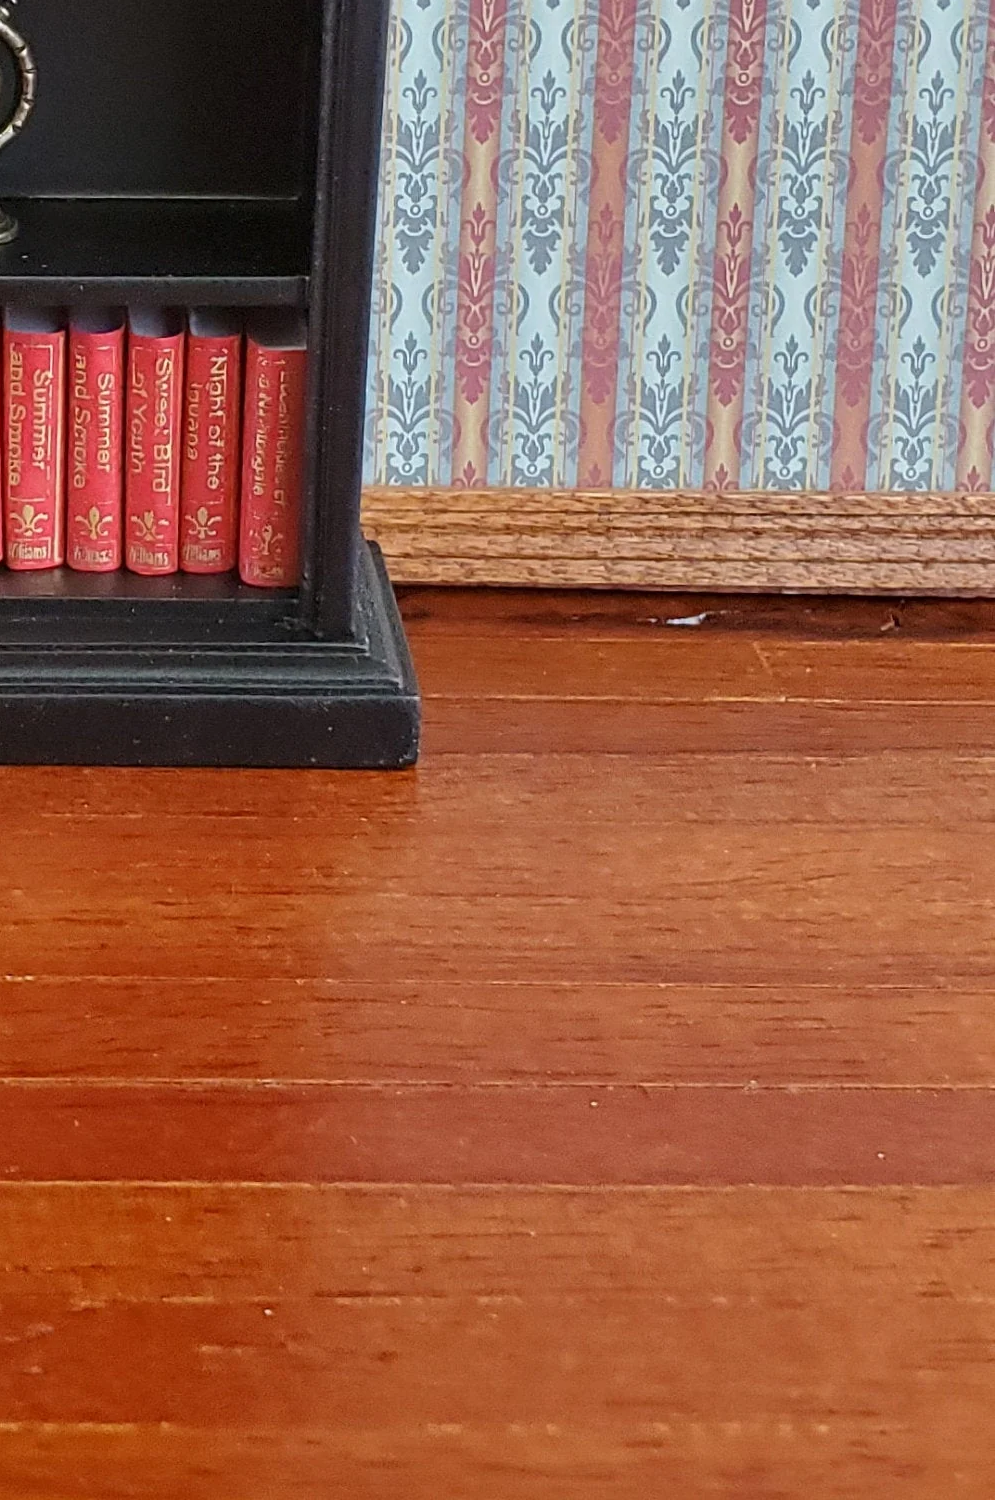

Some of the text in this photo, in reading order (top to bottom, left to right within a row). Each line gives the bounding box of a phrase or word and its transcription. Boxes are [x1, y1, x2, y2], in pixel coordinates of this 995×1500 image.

[9, 352, 27, 487] and Smoke
[32, 369, 53, 470] Summer
[73, 354, 94, 488] and Smoke
[96, 373, 115, 473] Summer
[131, 404, 148, 473] Youth
[152, 444, 171, 492] Bird
[205, 356, 228, 489] Night of the
